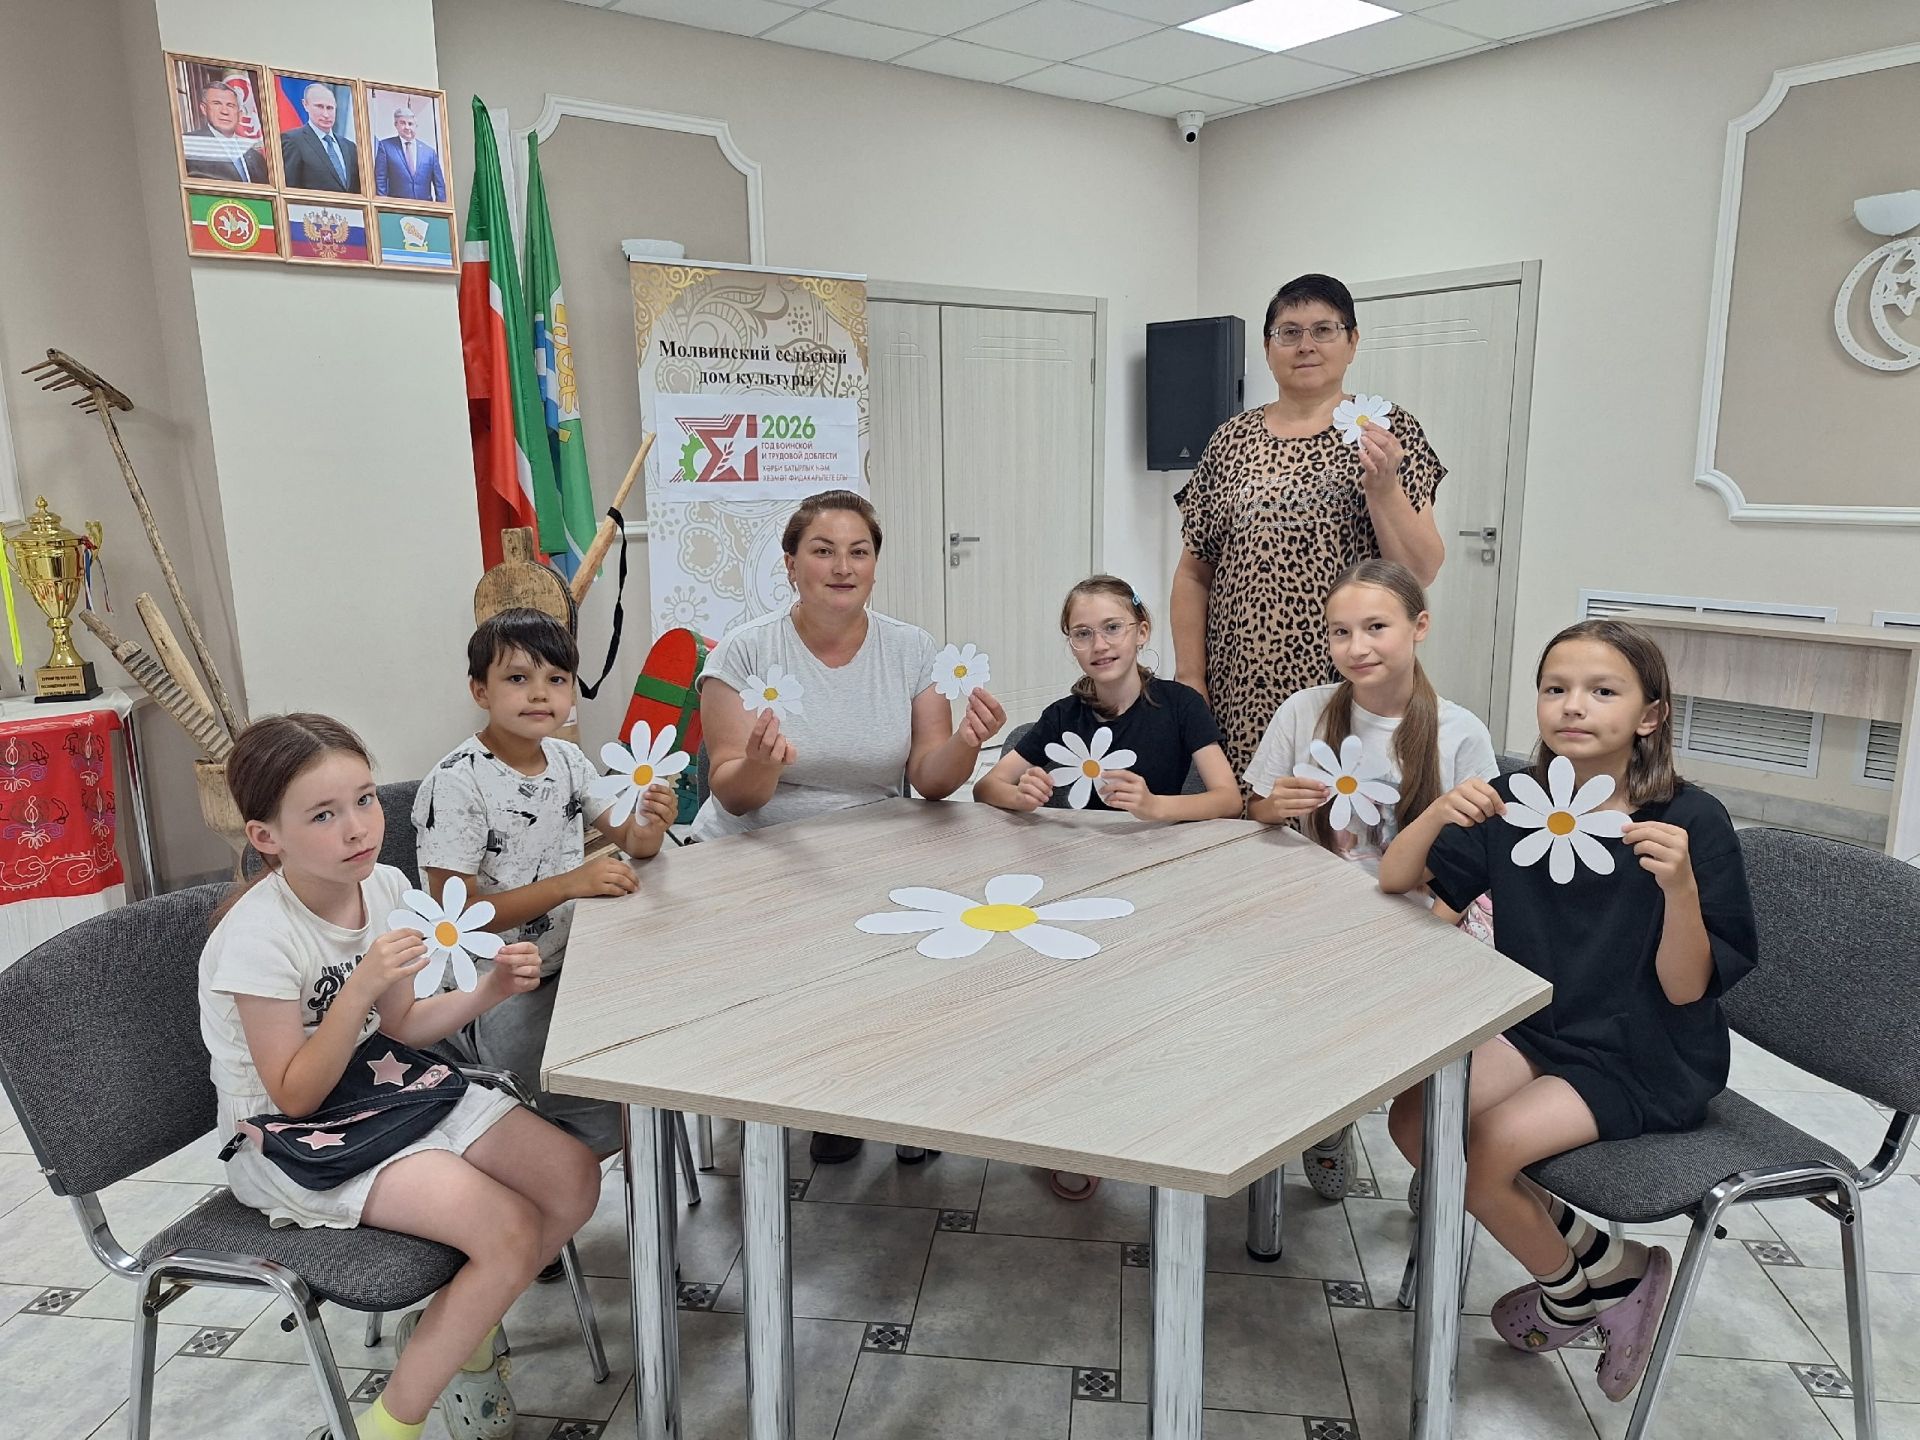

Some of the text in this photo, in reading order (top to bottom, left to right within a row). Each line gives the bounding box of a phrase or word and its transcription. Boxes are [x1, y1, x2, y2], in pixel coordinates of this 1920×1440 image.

[659, 340, 848, 365] Молвинский сельский
[699, 371, 814, 390] дом культуры
[762, 415, 816, 439] 2026
[761, 442, 775, 450] ГОД
[768, 451, 803, 461] ТРУДОВОЙ
[804, 452, 838, 461] ДОБЛЕСТИ
